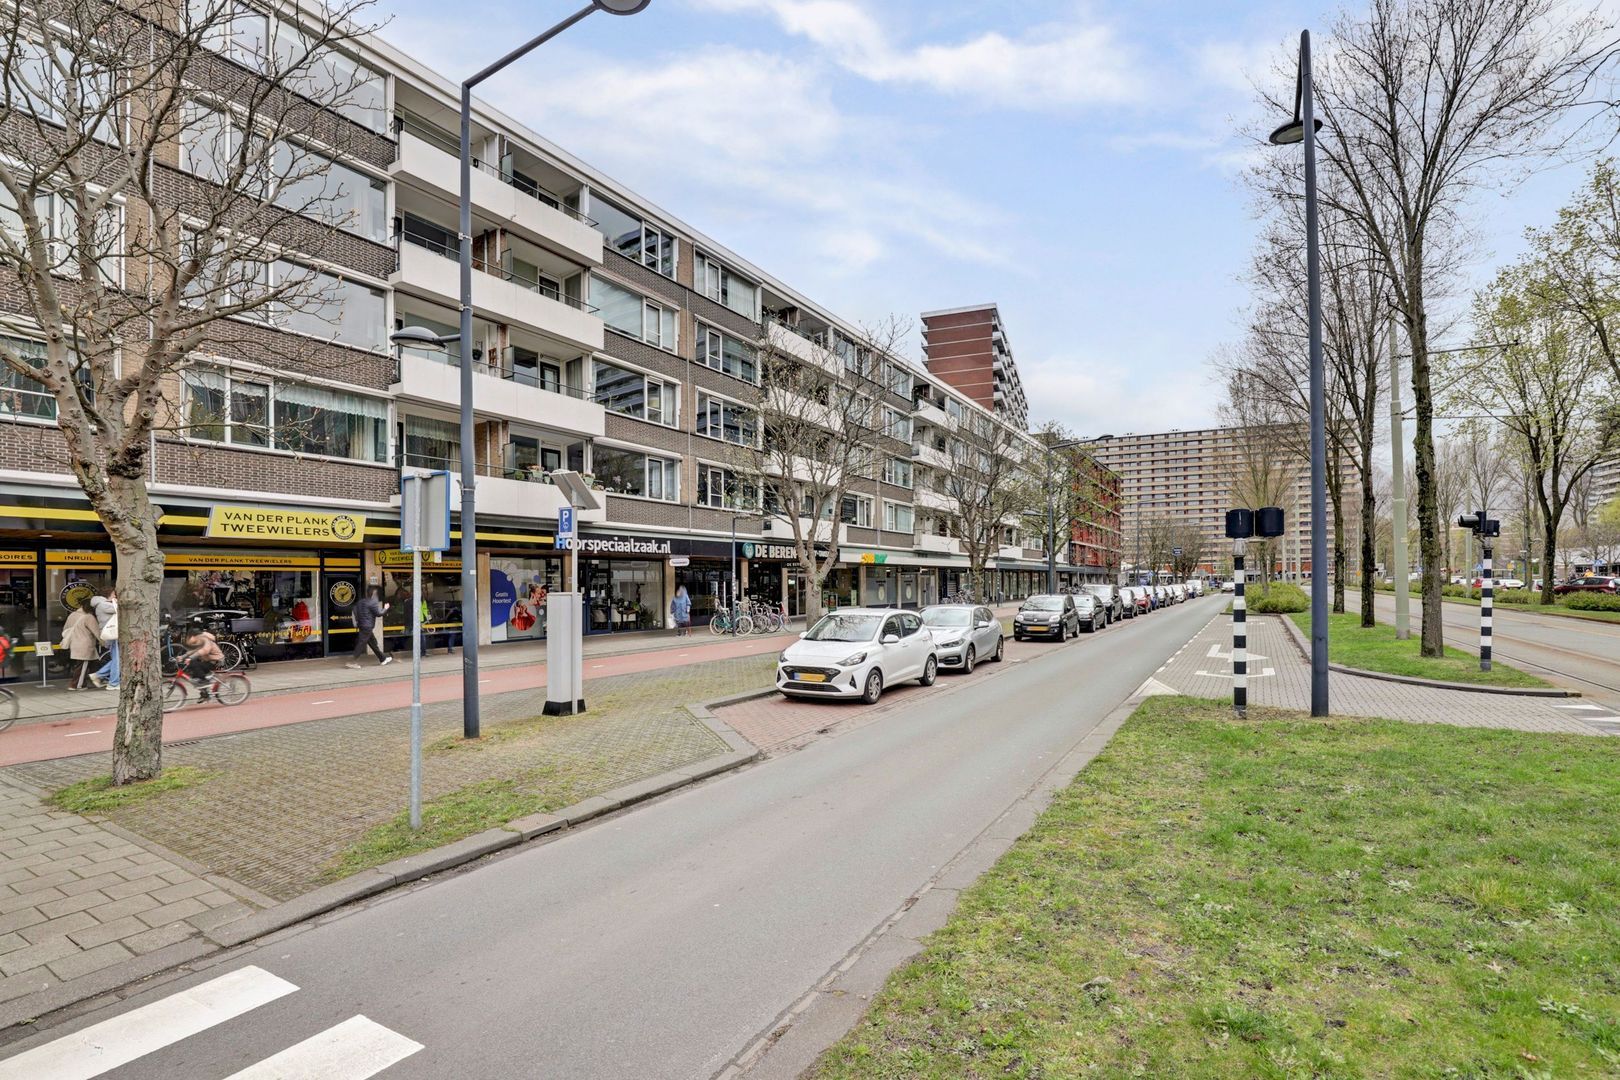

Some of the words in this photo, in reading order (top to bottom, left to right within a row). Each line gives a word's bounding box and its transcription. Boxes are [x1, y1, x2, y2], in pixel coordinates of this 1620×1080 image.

[224, 512, 253, 521] VAN
[257, 515, 283, 523] DER
[287, 517, 329, 526] PLANK
[562, 510, 569, 522] P
[221, 523, 330, 537] TWEEWIELERS
[755, 544, 768, 558] DE
